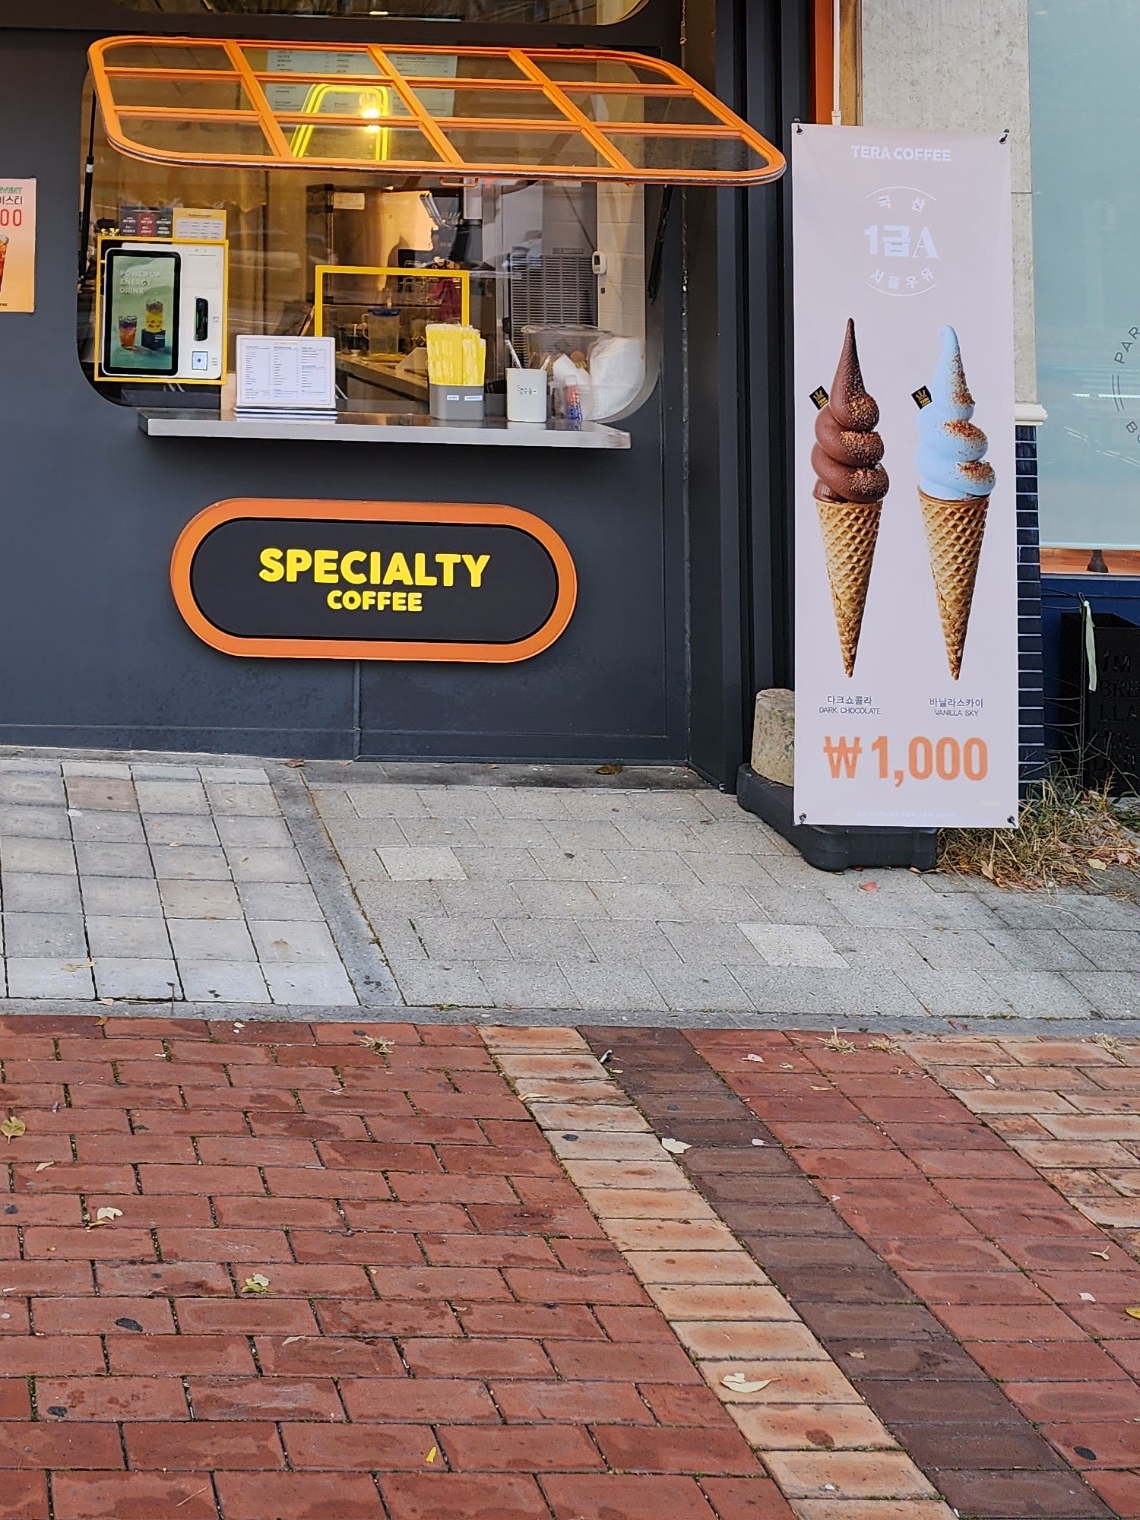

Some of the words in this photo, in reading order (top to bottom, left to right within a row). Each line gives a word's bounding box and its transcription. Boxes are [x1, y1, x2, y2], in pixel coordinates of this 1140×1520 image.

[850, 145, 891, 160] TERA
[893, 147, 952, 162] COFFEE
[864, 224, 940, 259] 1급A
[259, 547, 491, 588] SPECIALTY
[326, 589, 423, 613] COFFEE
[827, 695, 873, 706] 다크쇼콜라
[929, 697, 984, 709] 바닐라스카이
[819, 706, 838, 714] DARK
[840, 706, 882, 715] CHOCOLATE
[934, 709, 963, 717] VANILLA
[964, 709, 979, 717] SKY
